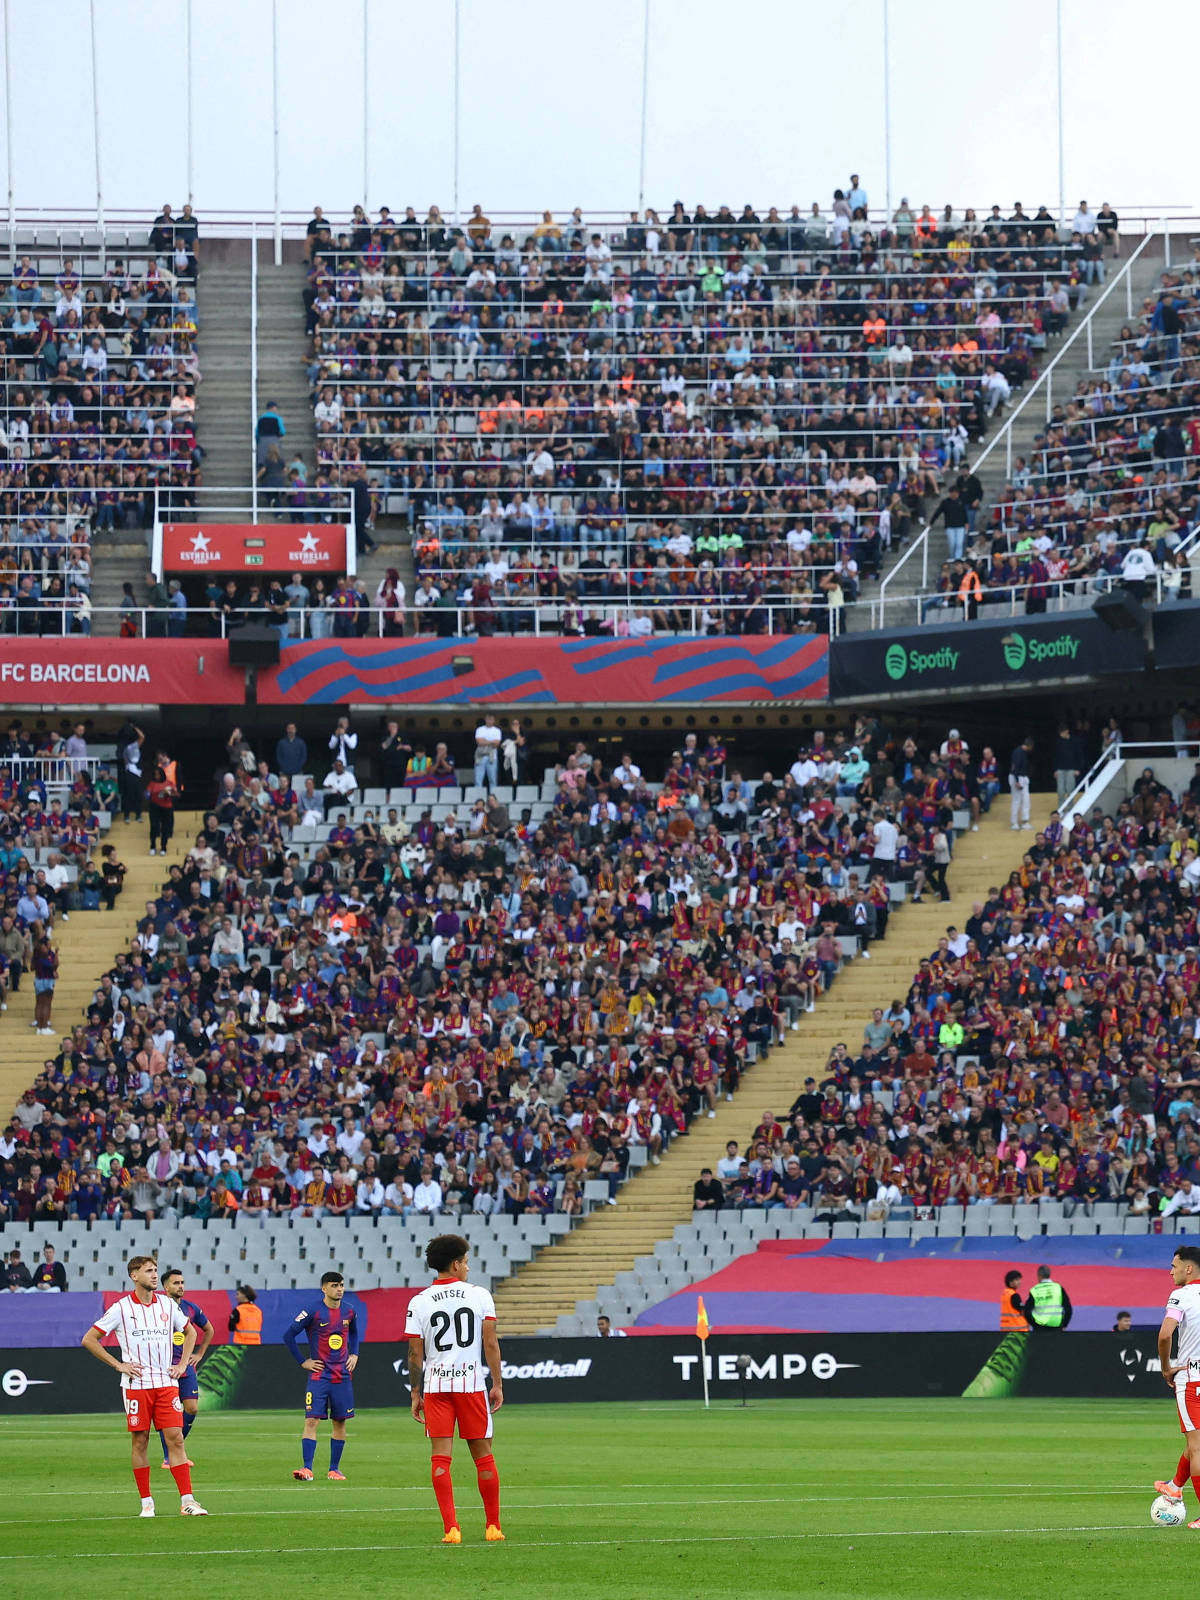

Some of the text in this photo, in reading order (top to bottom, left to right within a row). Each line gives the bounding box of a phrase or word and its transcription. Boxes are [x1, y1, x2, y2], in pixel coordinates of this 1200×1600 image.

[180, 551, 221, 561] ESTRELLA
[288, 551, 330, 561] ESTRELLA
[1029, 635, 1079, 662] Spotify
[909, 647, 958, 672] Spotify
[1, 663, 150, 682] FC BARCELONA
[432, 1289, 466, 1302] WITSEL
[132, 1329, 169, 1337] ETIHAD
[430, 1307, 475, 1352] 20
[433, 1367, 467, 1377] Marlex
[305, 1391, 313, 1405] 8
